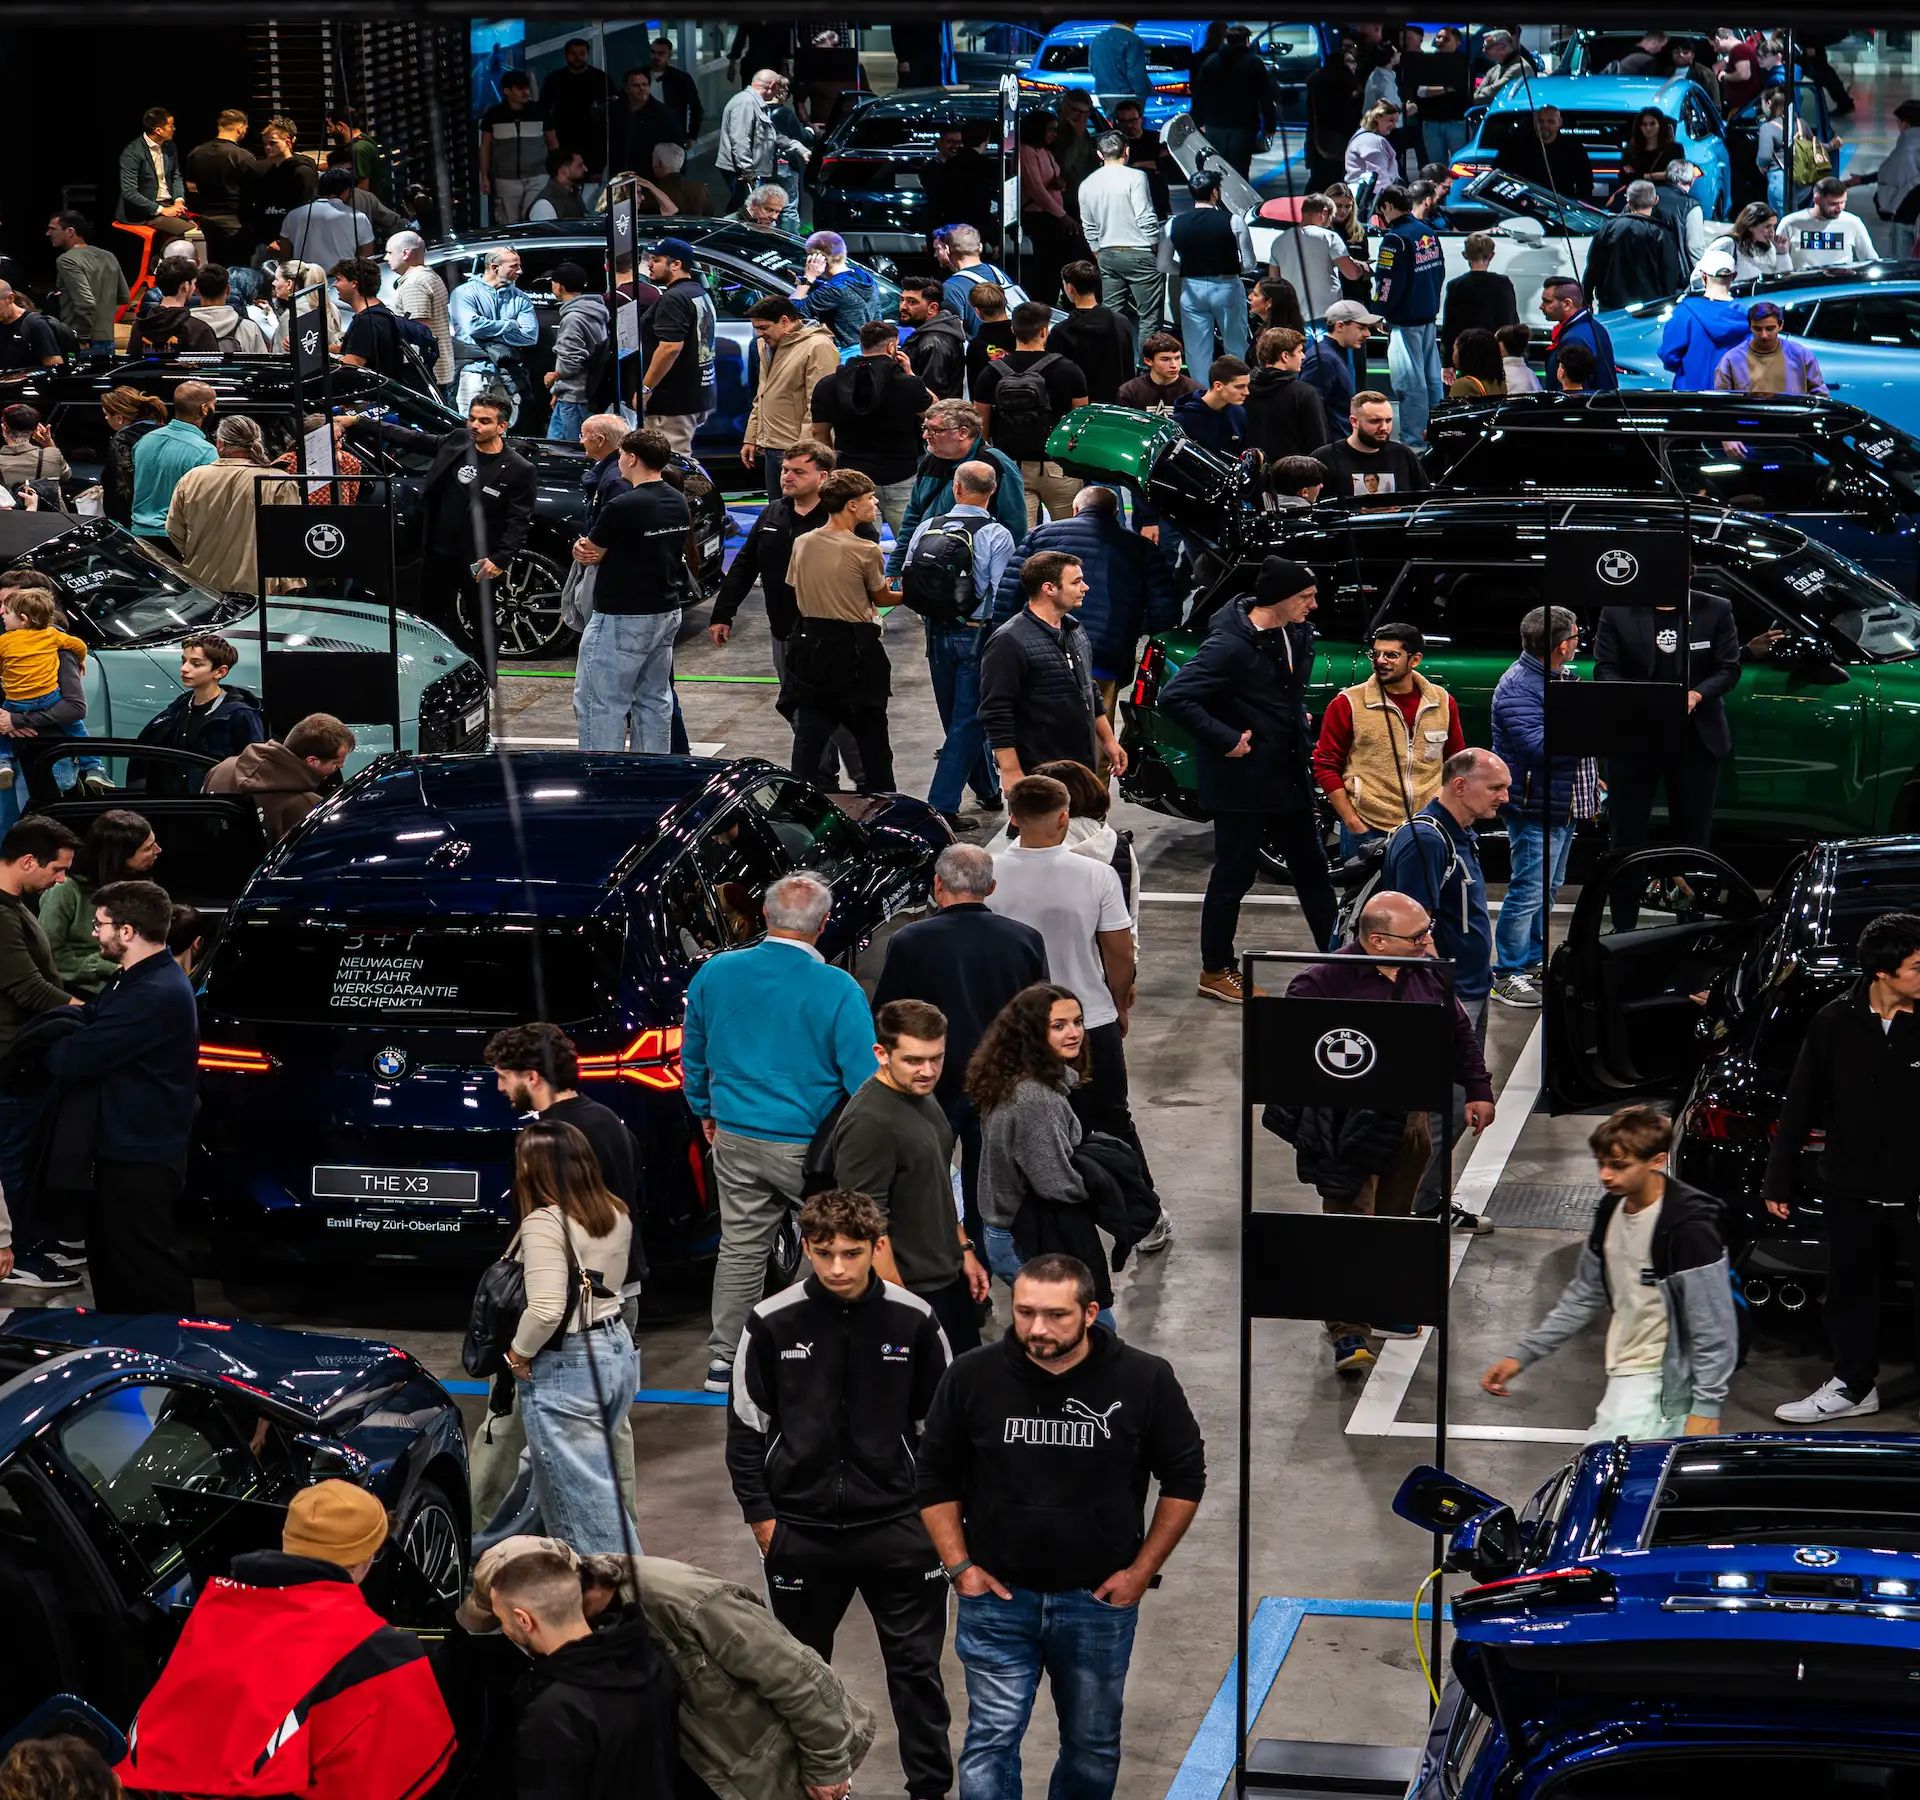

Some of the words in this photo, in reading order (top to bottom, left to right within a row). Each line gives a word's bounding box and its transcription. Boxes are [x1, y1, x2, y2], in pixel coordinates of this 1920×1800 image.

[311, 526, 339, 536] BMW
[1602, 552, 1633, 562] BMW
[60, 571, 74, 581] Für
[67, 574, 90, 590] CHF
[1792, 576, 1809, 592] CHF
[339, 956, 424, 969] NEUWAGEN
[336, 970, 363, 981] MIT
[365, 971, 371, 981] 1
[373, 971, 411, 982] JAHR
[333, 982, 458, 997] WERKSGARANTIE
[1323, 1031, 1368, 1047] BMW
[360, 1175, 400, 1191] THE
[404, 1177, 429, 1192] X3
[326, 1217, 353, 1229] Emil
[354, 1219, 381, 1231] Frey
[383, 1219, 461, 1232] Züri-Oberland
[781, 1350, 807, 1360] PUMA
[1004, 1418, 1094, 1447] PUMA
